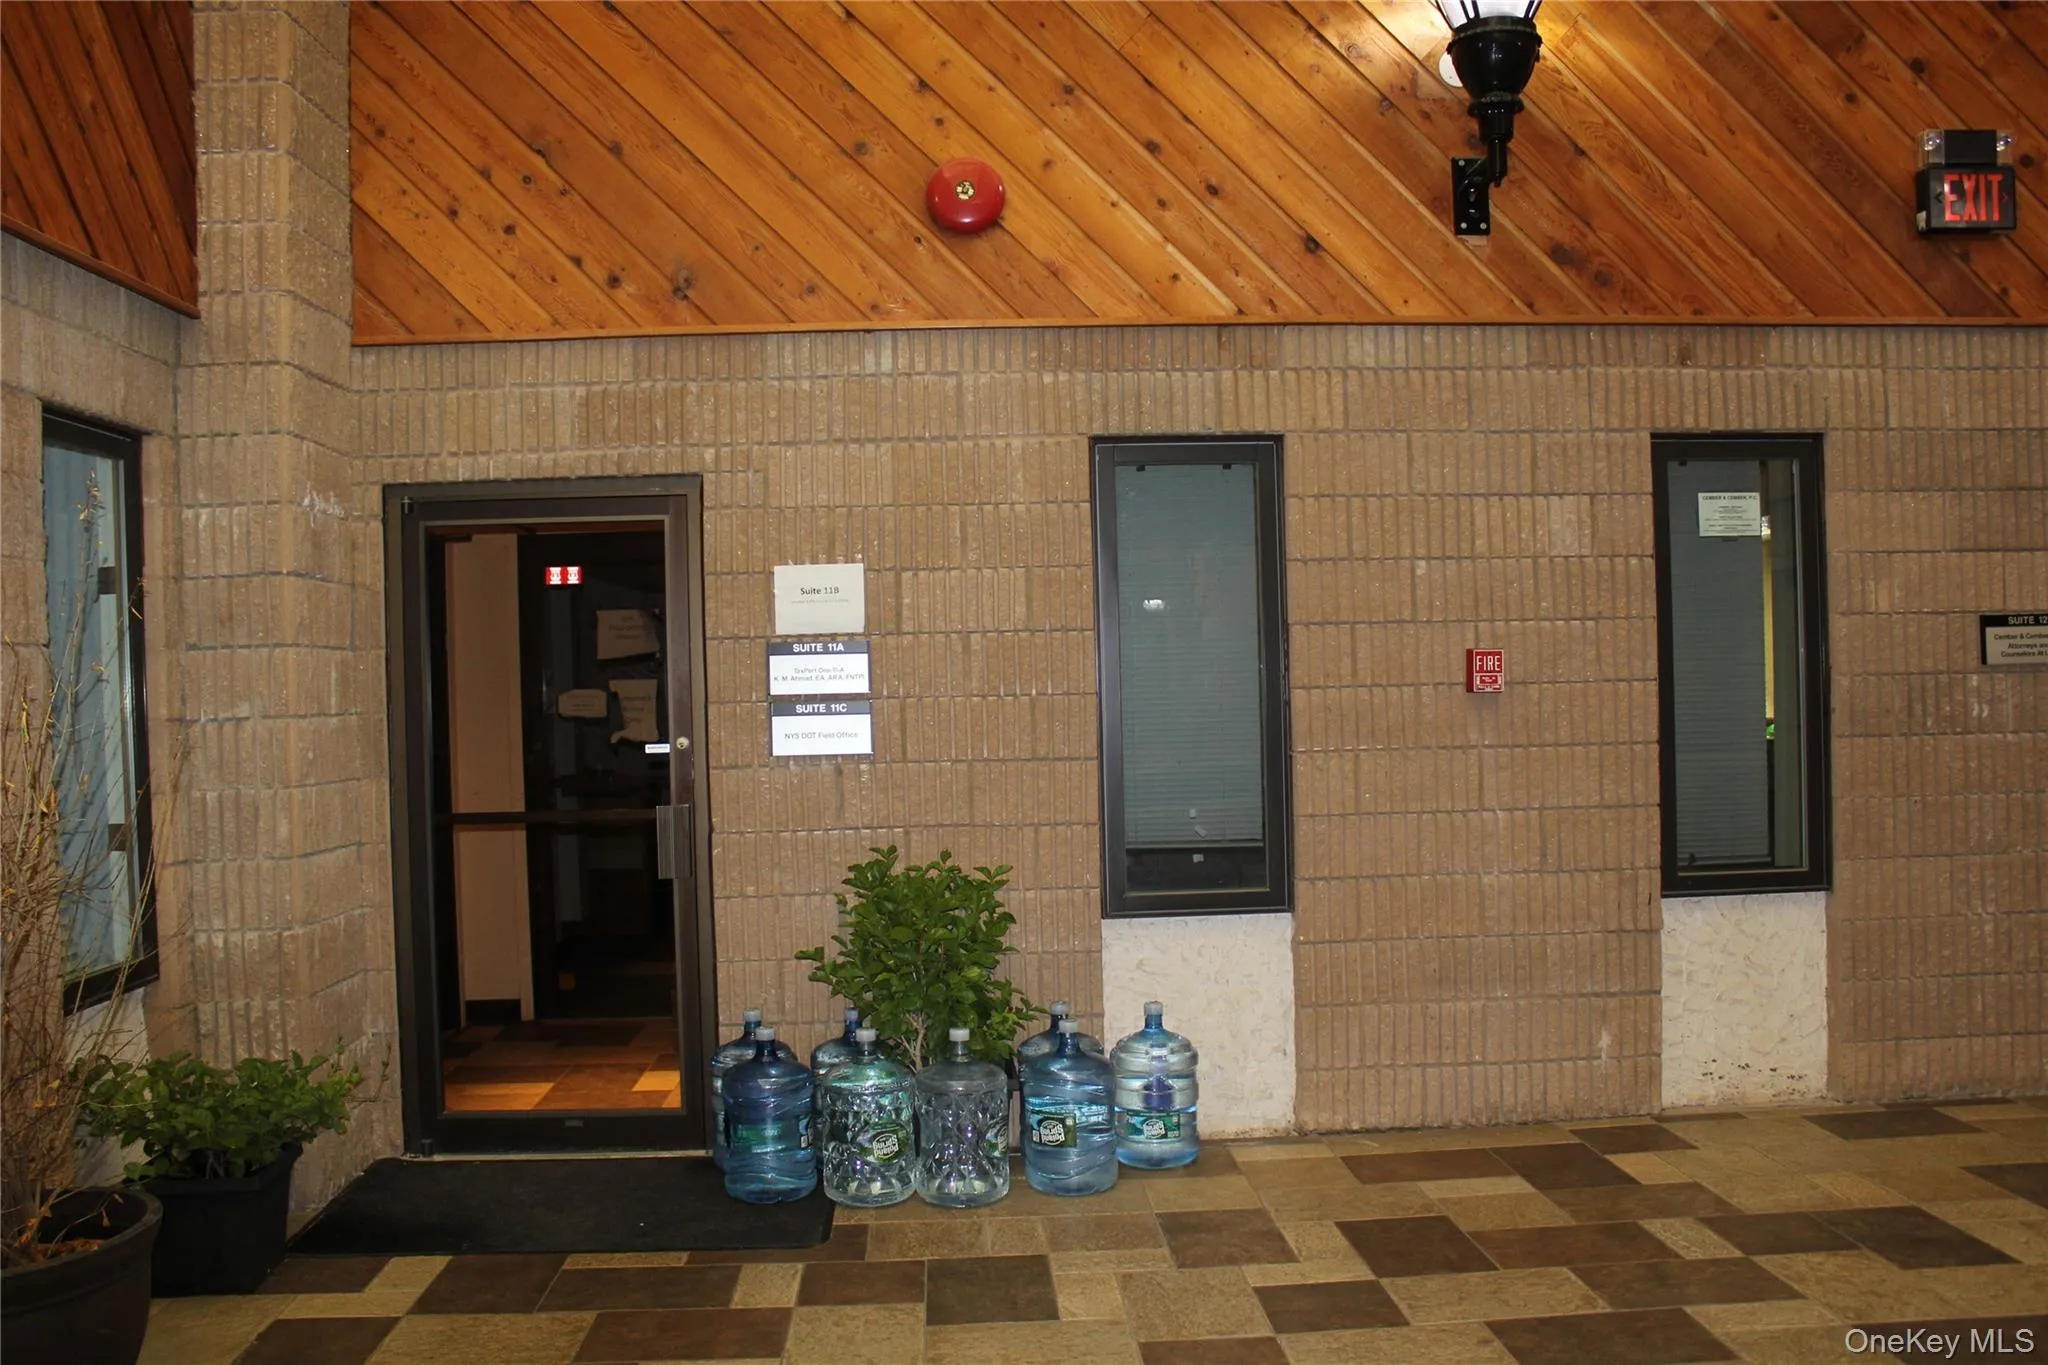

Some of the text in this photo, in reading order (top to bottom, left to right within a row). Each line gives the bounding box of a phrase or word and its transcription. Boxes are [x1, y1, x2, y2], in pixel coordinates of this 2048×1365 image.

[1944, 174, 2003, 221] EXIT
[800, 586, 840, 595] Suite 11B
[2008, 616, 2035, 624] SUITE
[792, 642, 845, 653] SUITE 11A
[2008, 642, 2037, 650] Attorneys
[1476, 655, 1501, 671] FIRE
[795, 703, 847, 713] SUITE 11C
[836, 731, 858, 739] Office
[872, 1135, 898, 1150] Spring
[874, 1142, 899, 1158] Poland
